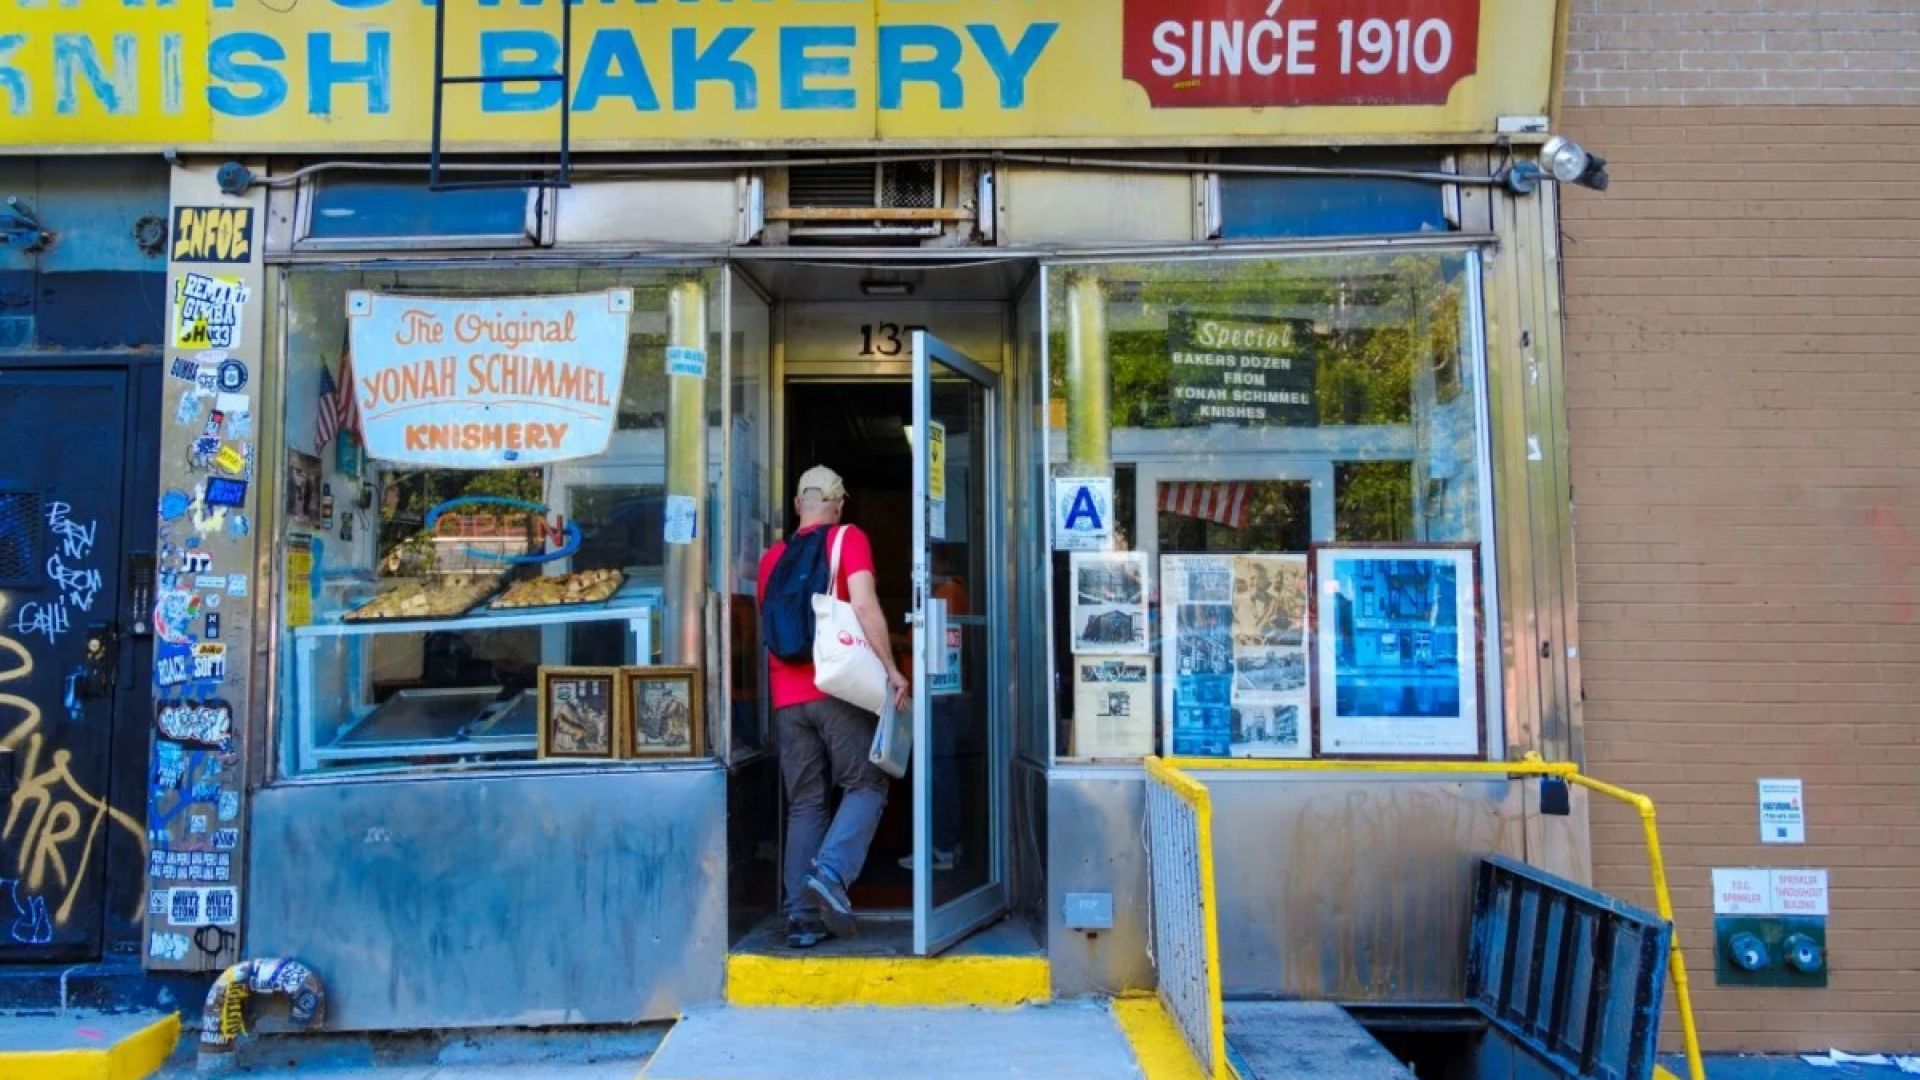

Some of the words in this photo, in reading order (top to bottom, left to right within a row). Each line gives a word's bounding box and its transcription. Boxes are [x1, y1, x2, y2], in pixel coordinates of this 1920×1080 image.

[1152, 20, 1318, 76] SINCE
[1337, 18, 1451, 75] 1910
[480, 22, 1059, 111] BAKERY
[396, 310, 444, 344] The
[455, 310, 577, 348] Original
[1200, 321, 1292, 349] Special
[1172, 352, 1236, 367] BAKERS
[1240, 356, 1291, 370] DOZEN
[363, 355, 457, 408] YONAH
[468, 354, 609, 405] SCHIMMEL
[1223, 372, 1265, 385] FROM
[1175, 386, 1227, 399] YONAH
[1232, 390, 1309, 404] SCHIMMEL
[1200, 405, 1266, 419] KNISHES
[405, 422, 568, 450] KNISHERY
[1064, 486, 1102, 529] A
[436, 512, 563, 547] OPEN
[1779, 875, 1818, 885] SPRINKLER
[1723, 892, 1761, 903] SPRINKLER
[1774, 887, 1824, 897] THROUGHOUT
[1784, 900, 1816, 909] BUILDING
